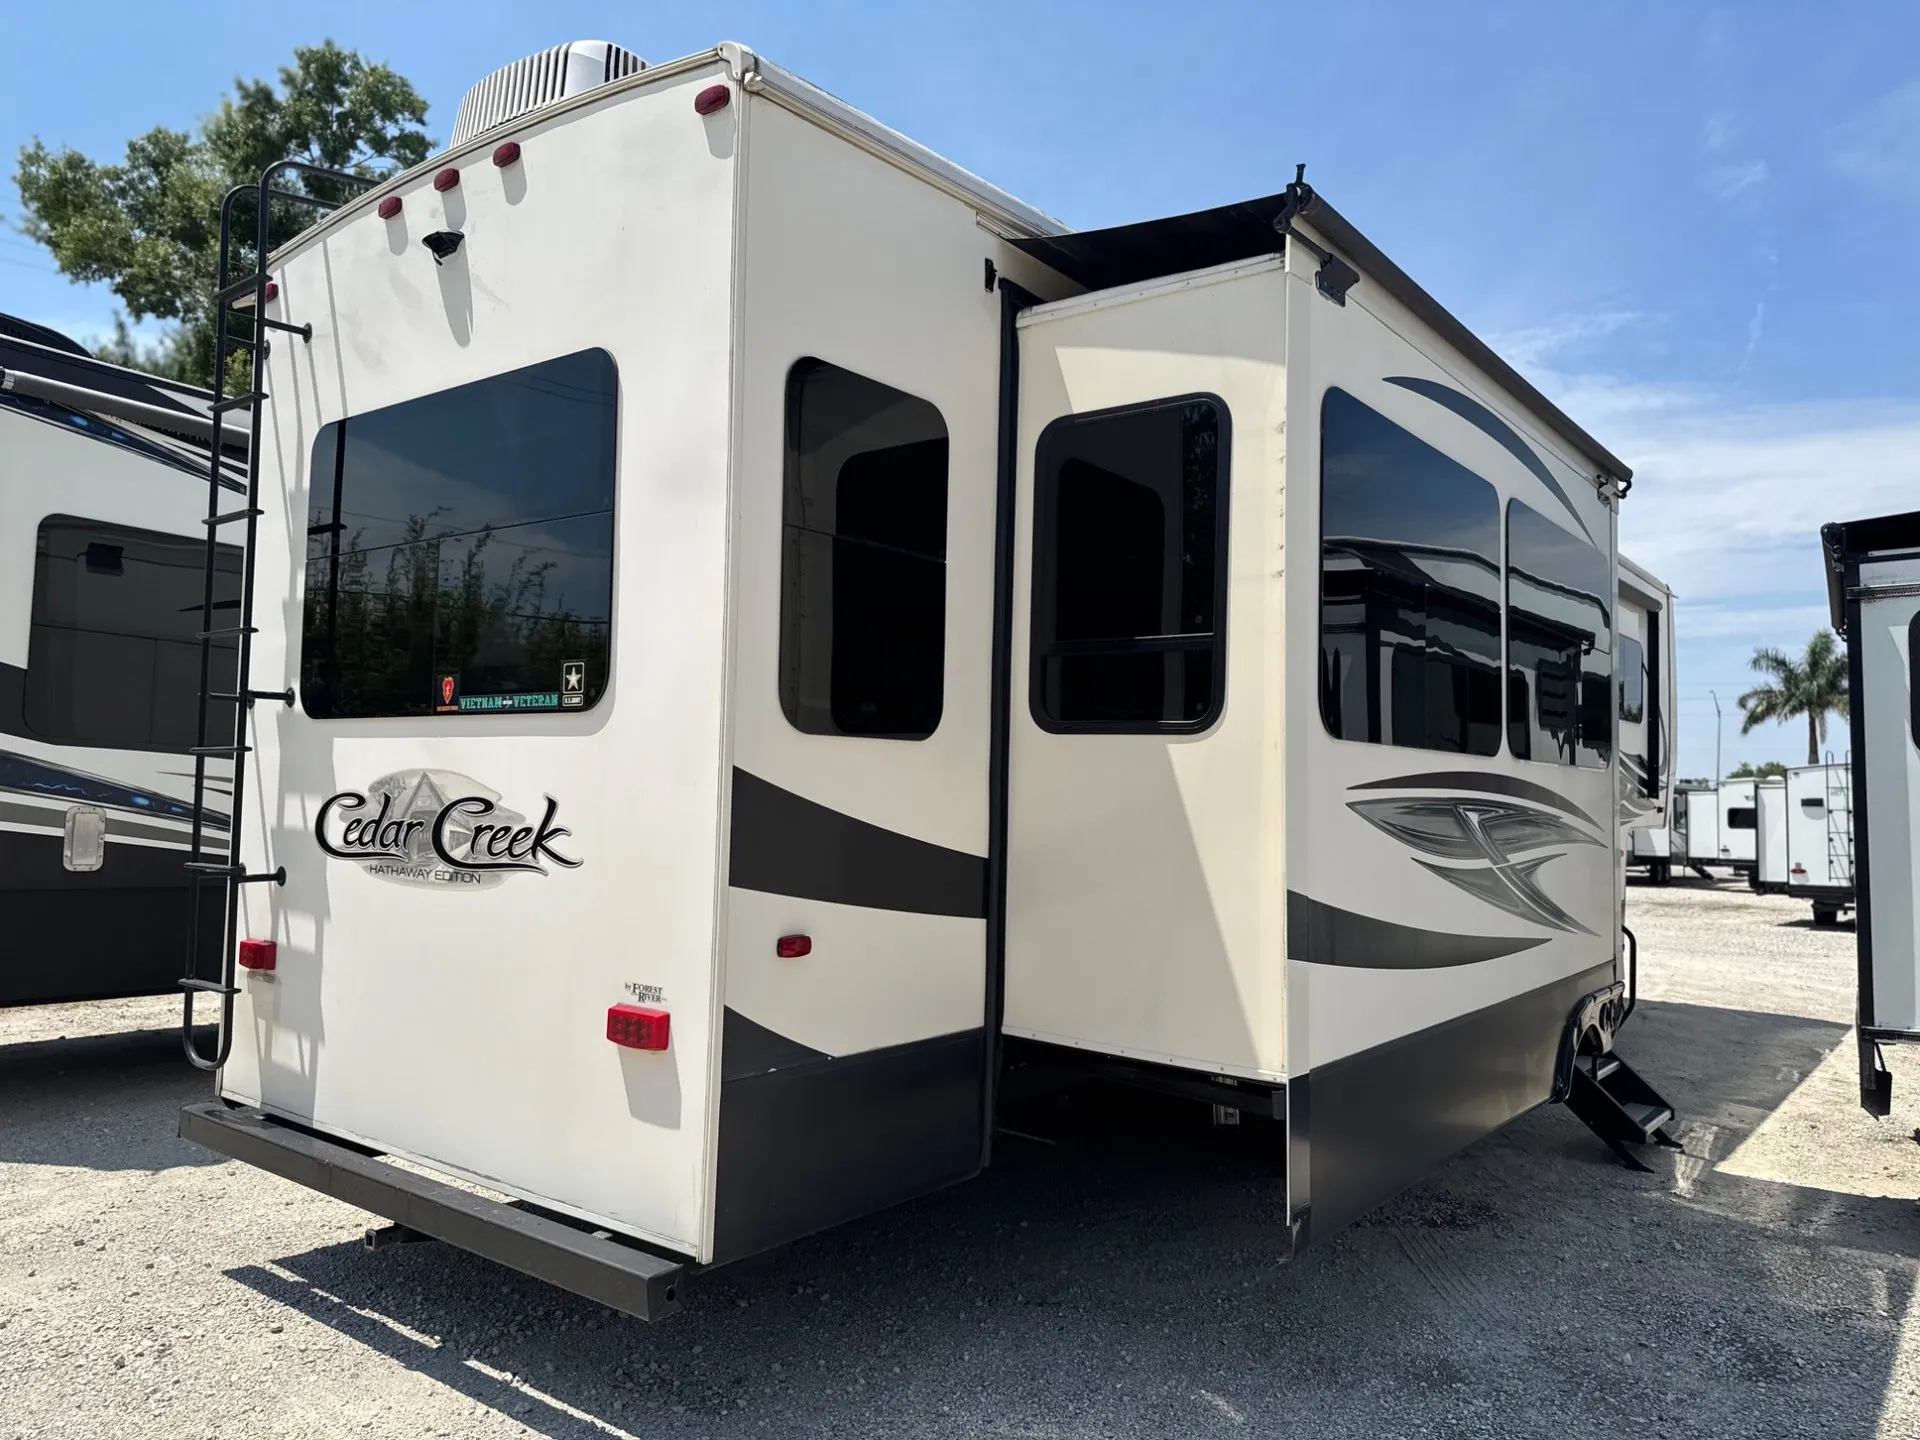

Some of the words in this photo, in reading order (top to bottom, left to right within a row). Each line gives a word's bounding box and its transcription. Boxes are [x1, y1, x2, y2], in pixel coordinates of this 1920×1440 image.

[460, 697, 502, 709] VIETNAM
[513, 695, 558, 708] VETERAN
[315, 791, 424, 861] Cedar
[431, 792, 584, 877] Creek
[369, 863, 433, 880] HATHAWAY
[434, 871, 482, 884] EDITION
[632, 982, 663, 995] FOREST
[638, 991, 661, 1003] RIVER
